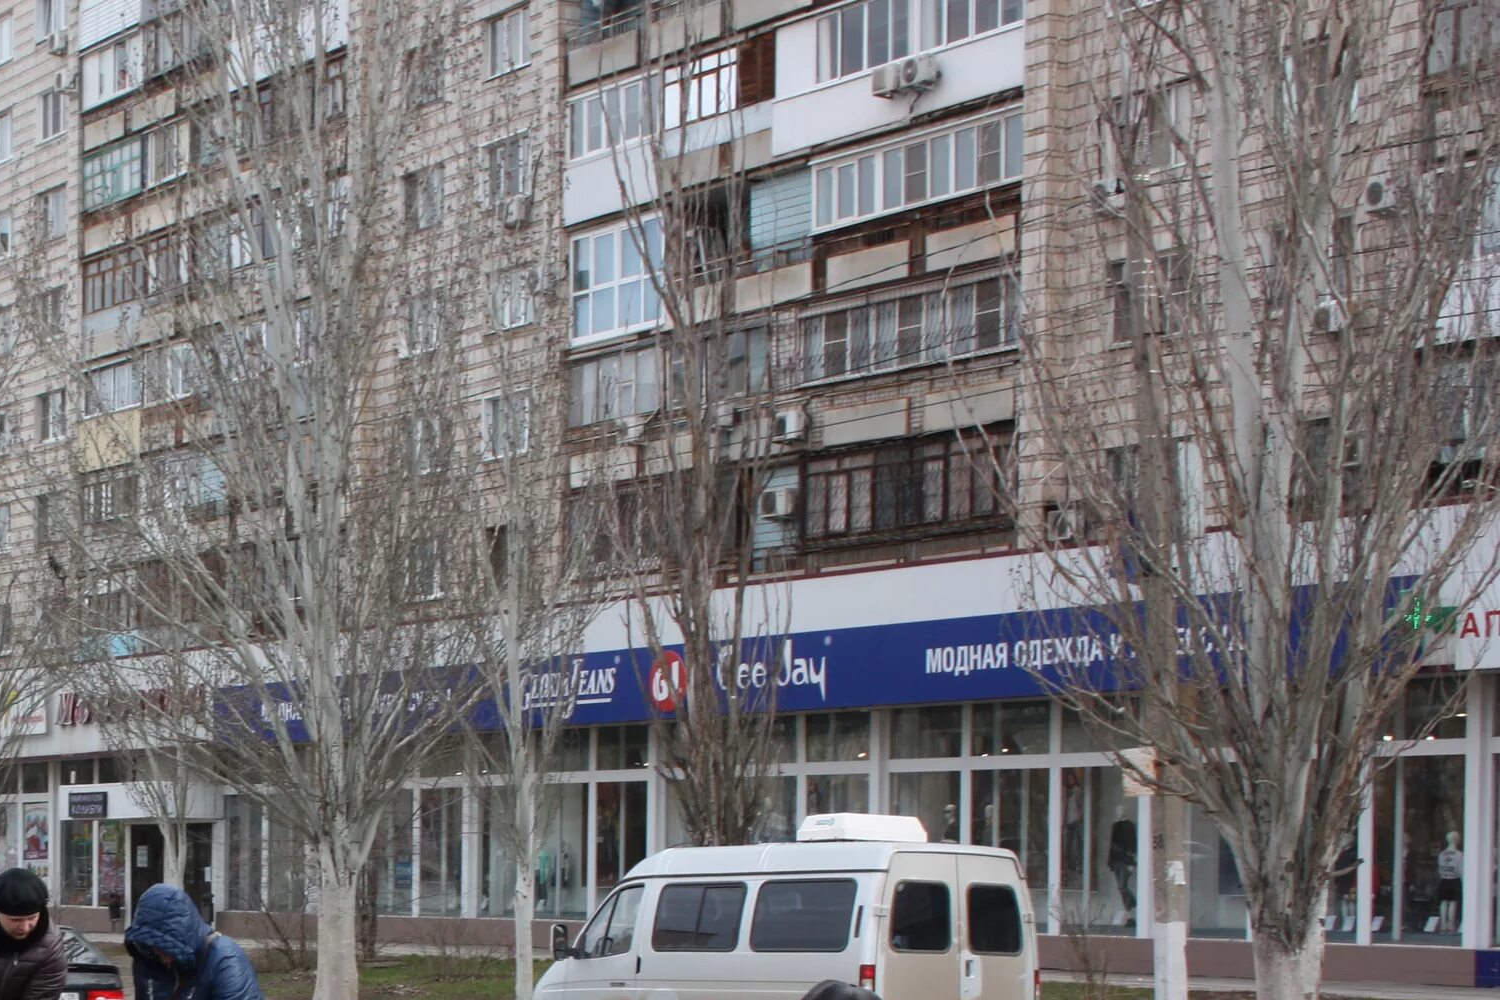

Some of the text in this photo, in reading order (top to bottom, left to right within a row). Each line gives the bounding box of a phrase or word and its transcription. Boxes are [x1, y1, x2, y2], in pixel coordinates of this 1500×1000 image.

[776, 639, 827, 702] Jay
[925, 641, 1008, 676] МОДНАЯ
[1014, 635, 1104, 669] ОДЕЖДА
[562, 658, 617, 718] JEANS
